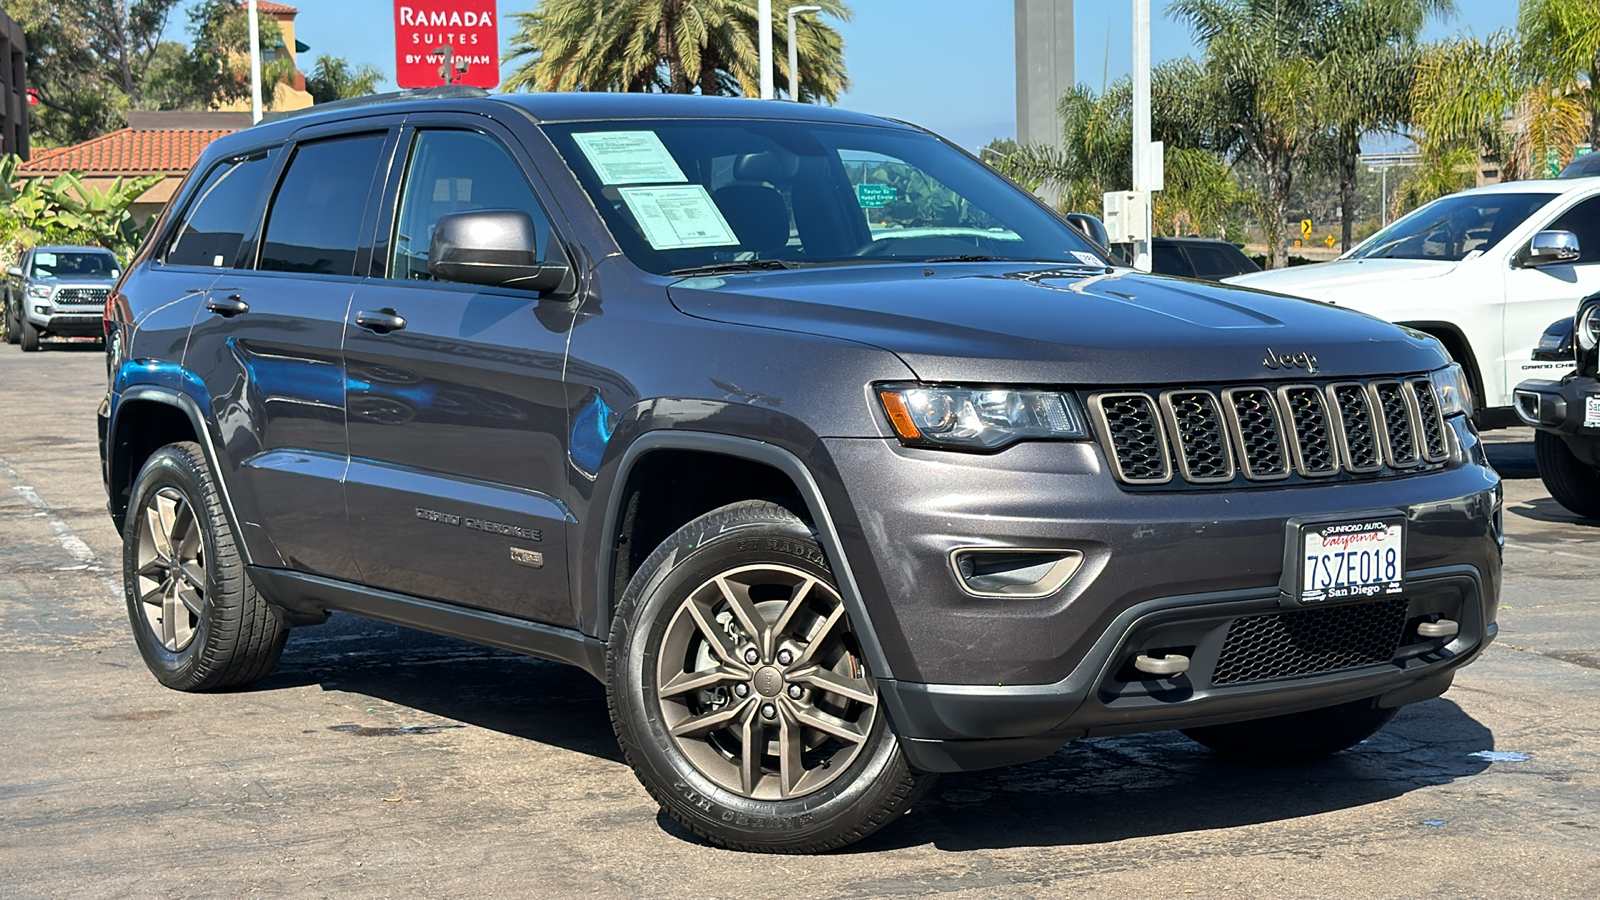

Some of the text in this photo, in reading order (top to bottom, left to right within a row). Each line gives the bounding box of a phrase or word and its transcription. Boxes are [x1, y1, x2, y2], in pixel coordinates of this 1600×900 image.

[400, 6, 492, 27] RAMADA
[412, 33, 478, 44] SUITES
[405, 54, 490, 64] BY WYDHAM
[1262, 347, 1319, 375] Jeep
[415, 507, 543, 541] GRAND CHEROKEE
[1327, 522, 1383, 534] SUNROAD AUTO
[1322, 532, 1385, 550] California
[765, 539, 827, 569] RADIA
[1307, 548, 1396, 590] 7SZE018
[1328, 588, 1348, 597] San
[1351, 585, 1380, 596] Diego
